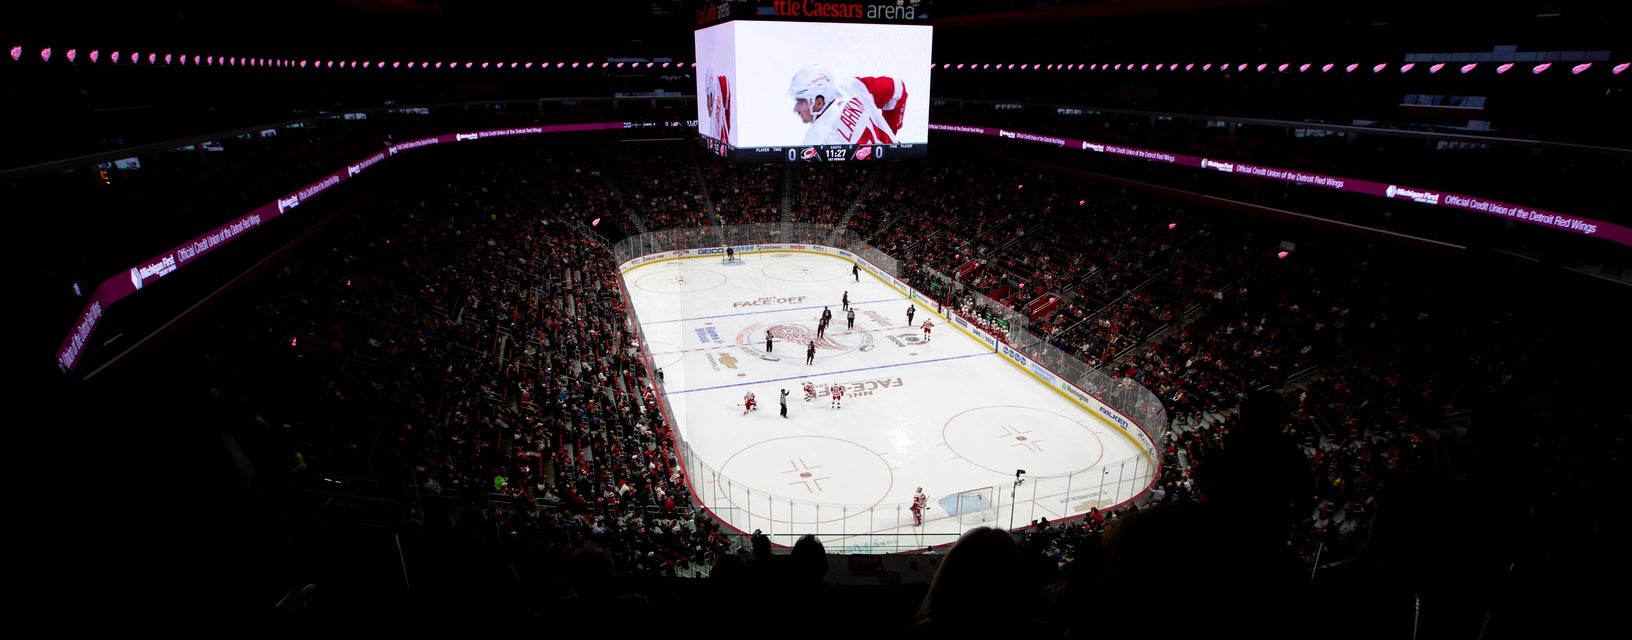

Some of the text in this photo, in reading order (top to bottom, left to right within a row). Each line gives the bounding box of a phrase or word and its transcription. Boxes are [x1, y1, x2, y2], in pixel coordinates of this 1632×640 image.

[803, 0, 863, 18] Caesars
[867, 4, 914, 19] arena
[788, 148, 796, 161] 0
[826, 149, 846, 158] 11:27
[876, 146, 883, 158] 0
[1236, 164, 1252, 174] Official
[1252, 166, 1266, 176] Credit
[1266, 169, 1281, 178] Union
[1287, 172, 1296, 180] the
[1296, 174, 1314, 183] Detroit
[1314, 176, 1326, 185] Red
[1326, 178, 1344, 188] Wings
[1396, 188, 1439, 201] Michigan First
[1444, 194, 1597, 234] Official Credit Union of the Detroit Red Wings
[178, 214, 261, 262] Official Credit Union of the Detroit Red Wings
[733, 296, 806, 308] FACE-OFF
[1099, 406, 1128, 428] FALKEN
